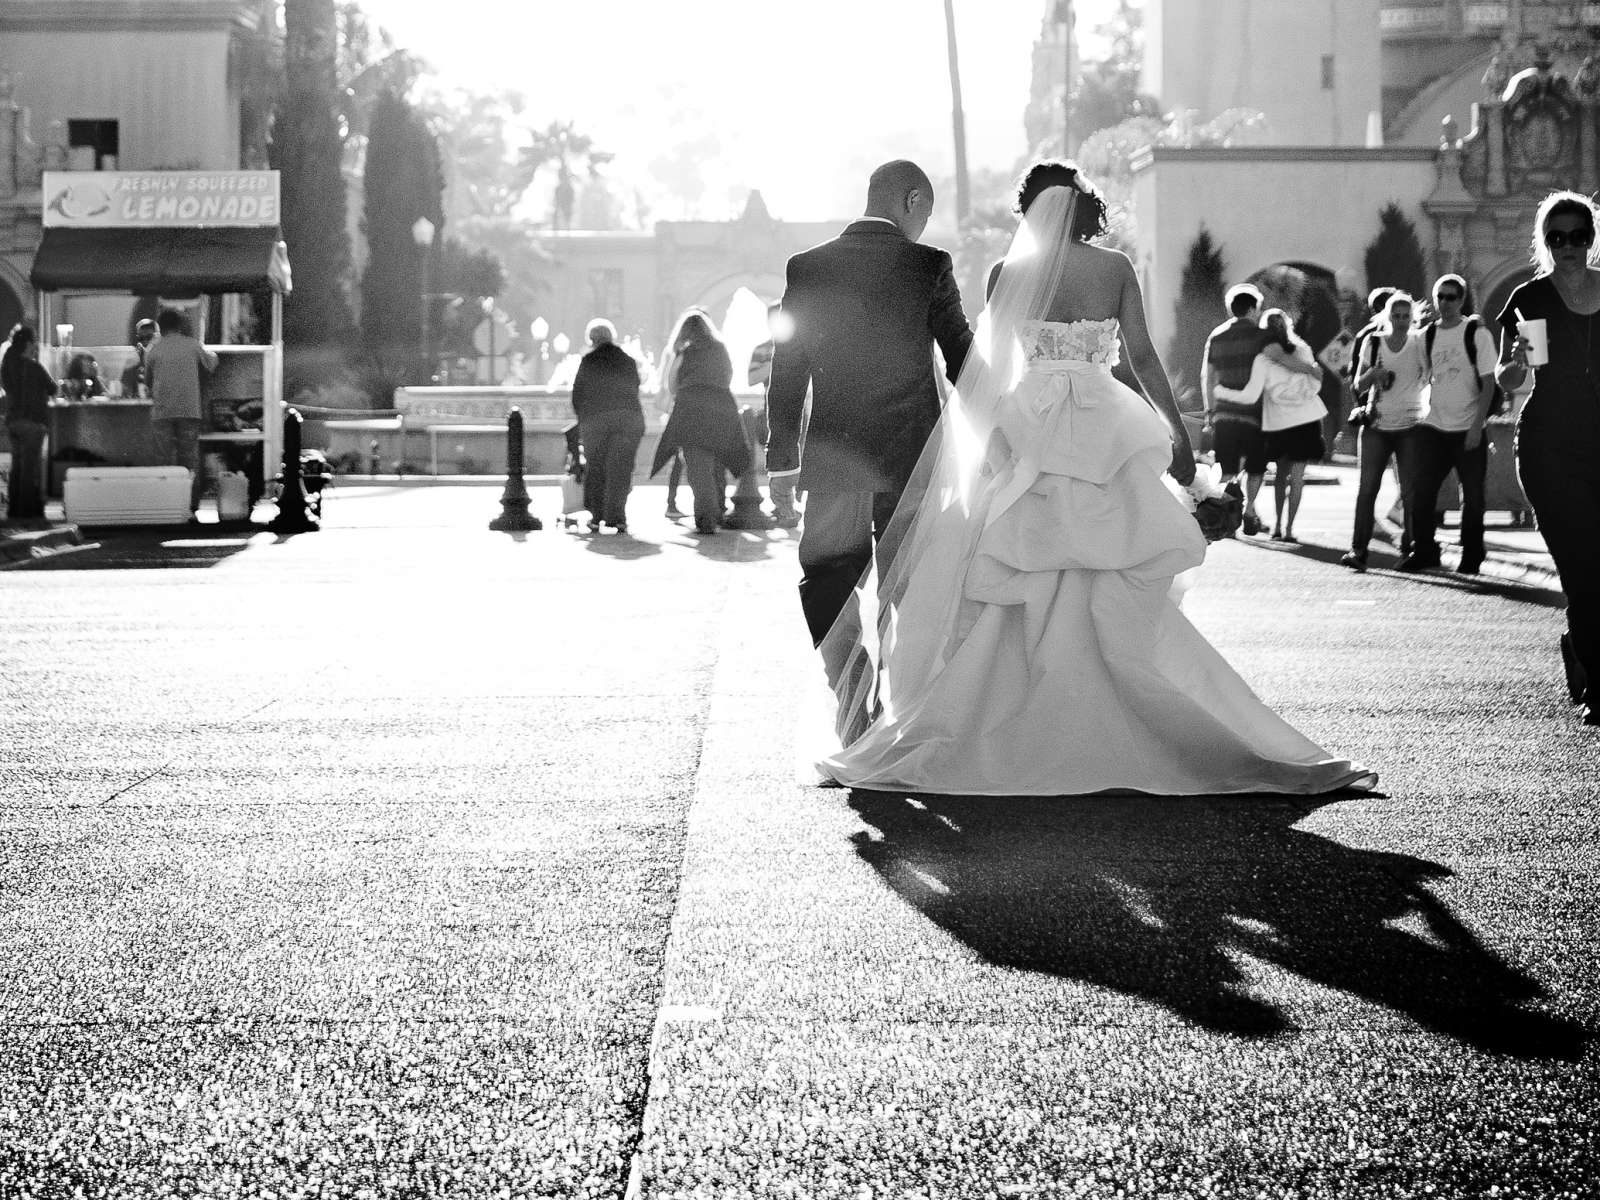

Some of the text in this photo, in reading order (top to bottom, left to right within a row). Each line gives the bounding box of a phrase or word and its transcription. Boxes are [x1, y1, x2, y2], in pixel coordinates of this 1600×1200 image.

[112, 176, 269, 192] FRESHLY SQUEEZED
[122, 196, 274, 219] LEMONADE
